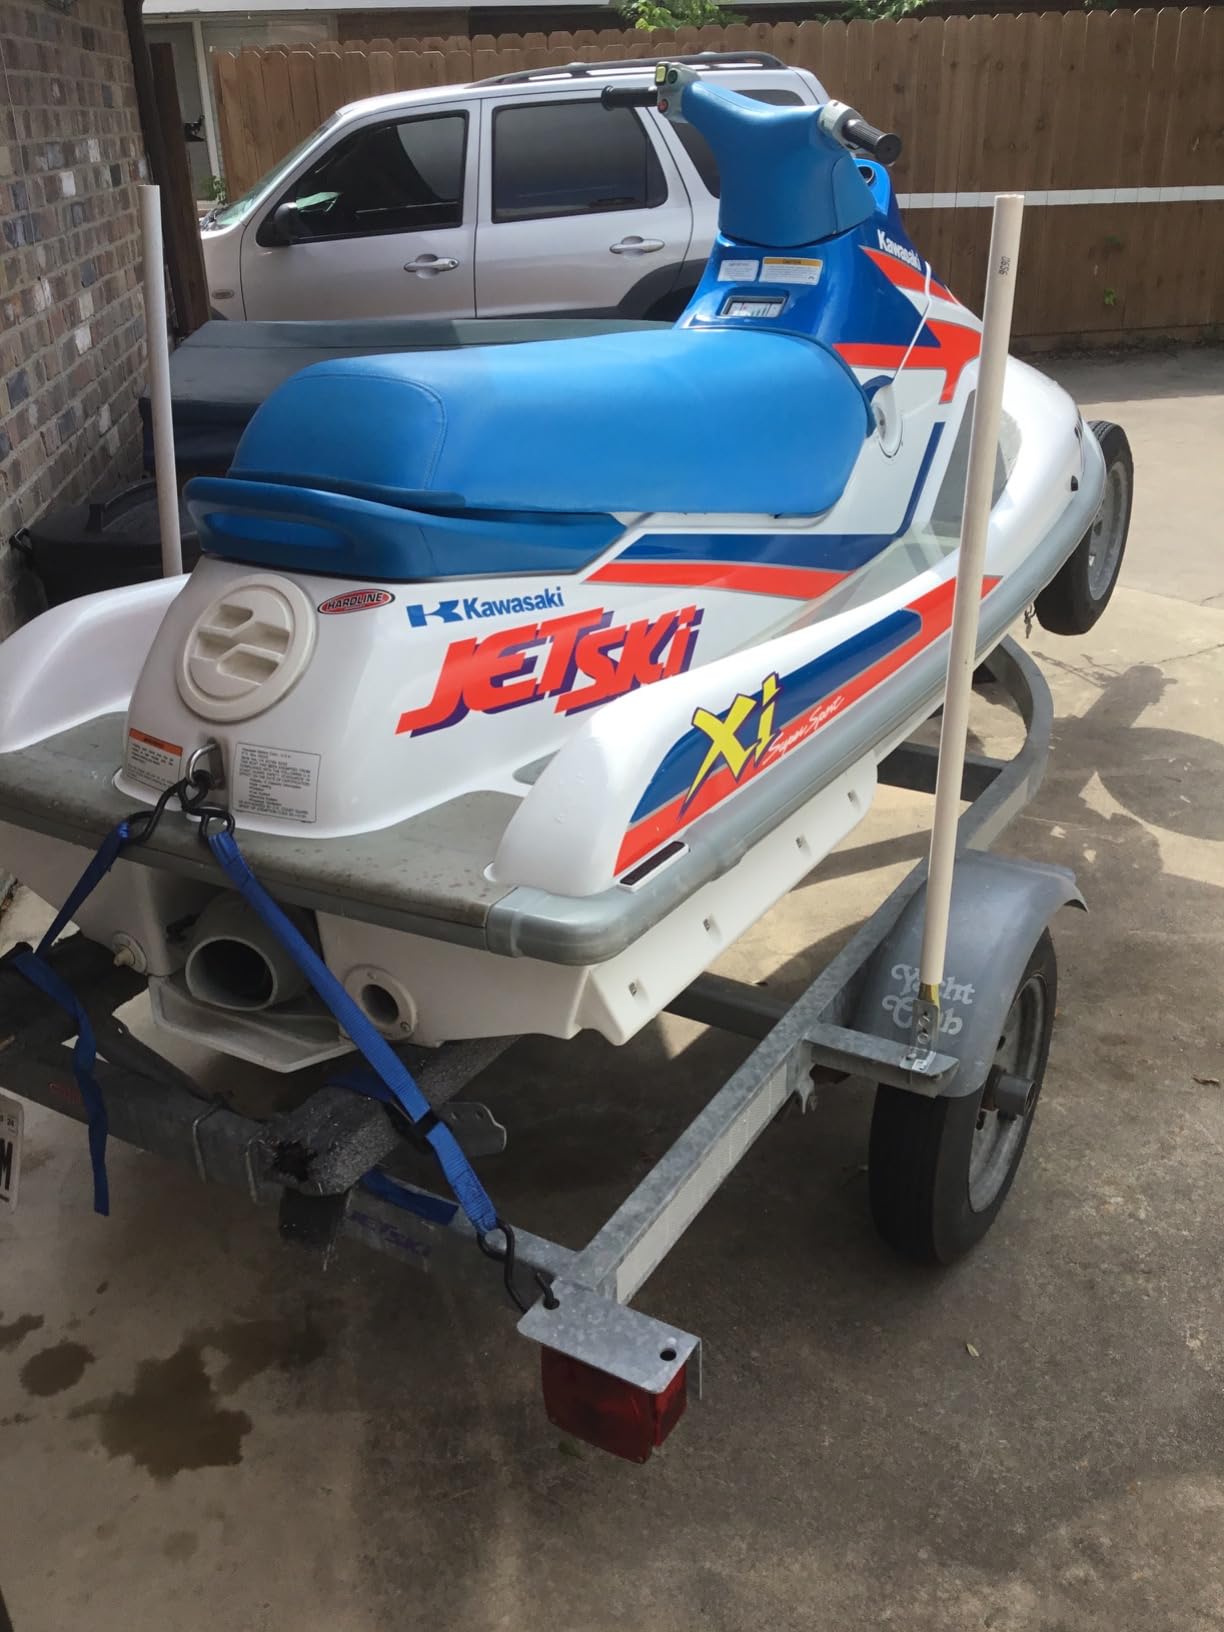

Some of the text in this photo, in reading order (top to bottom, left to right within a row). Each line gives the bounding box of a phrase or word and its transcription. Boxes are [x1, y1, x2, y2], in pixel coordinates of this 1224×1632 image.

[876, 228, 922, 271] Kawasaki
[326, 592, 384, 610] HARDLINE
[463, 586, 565, 620] Kawasaki
[677, 671, 782, 822] Xi
[891, 963, 975, 1005] Yht
[882, 994, 963, 1035] Cb
